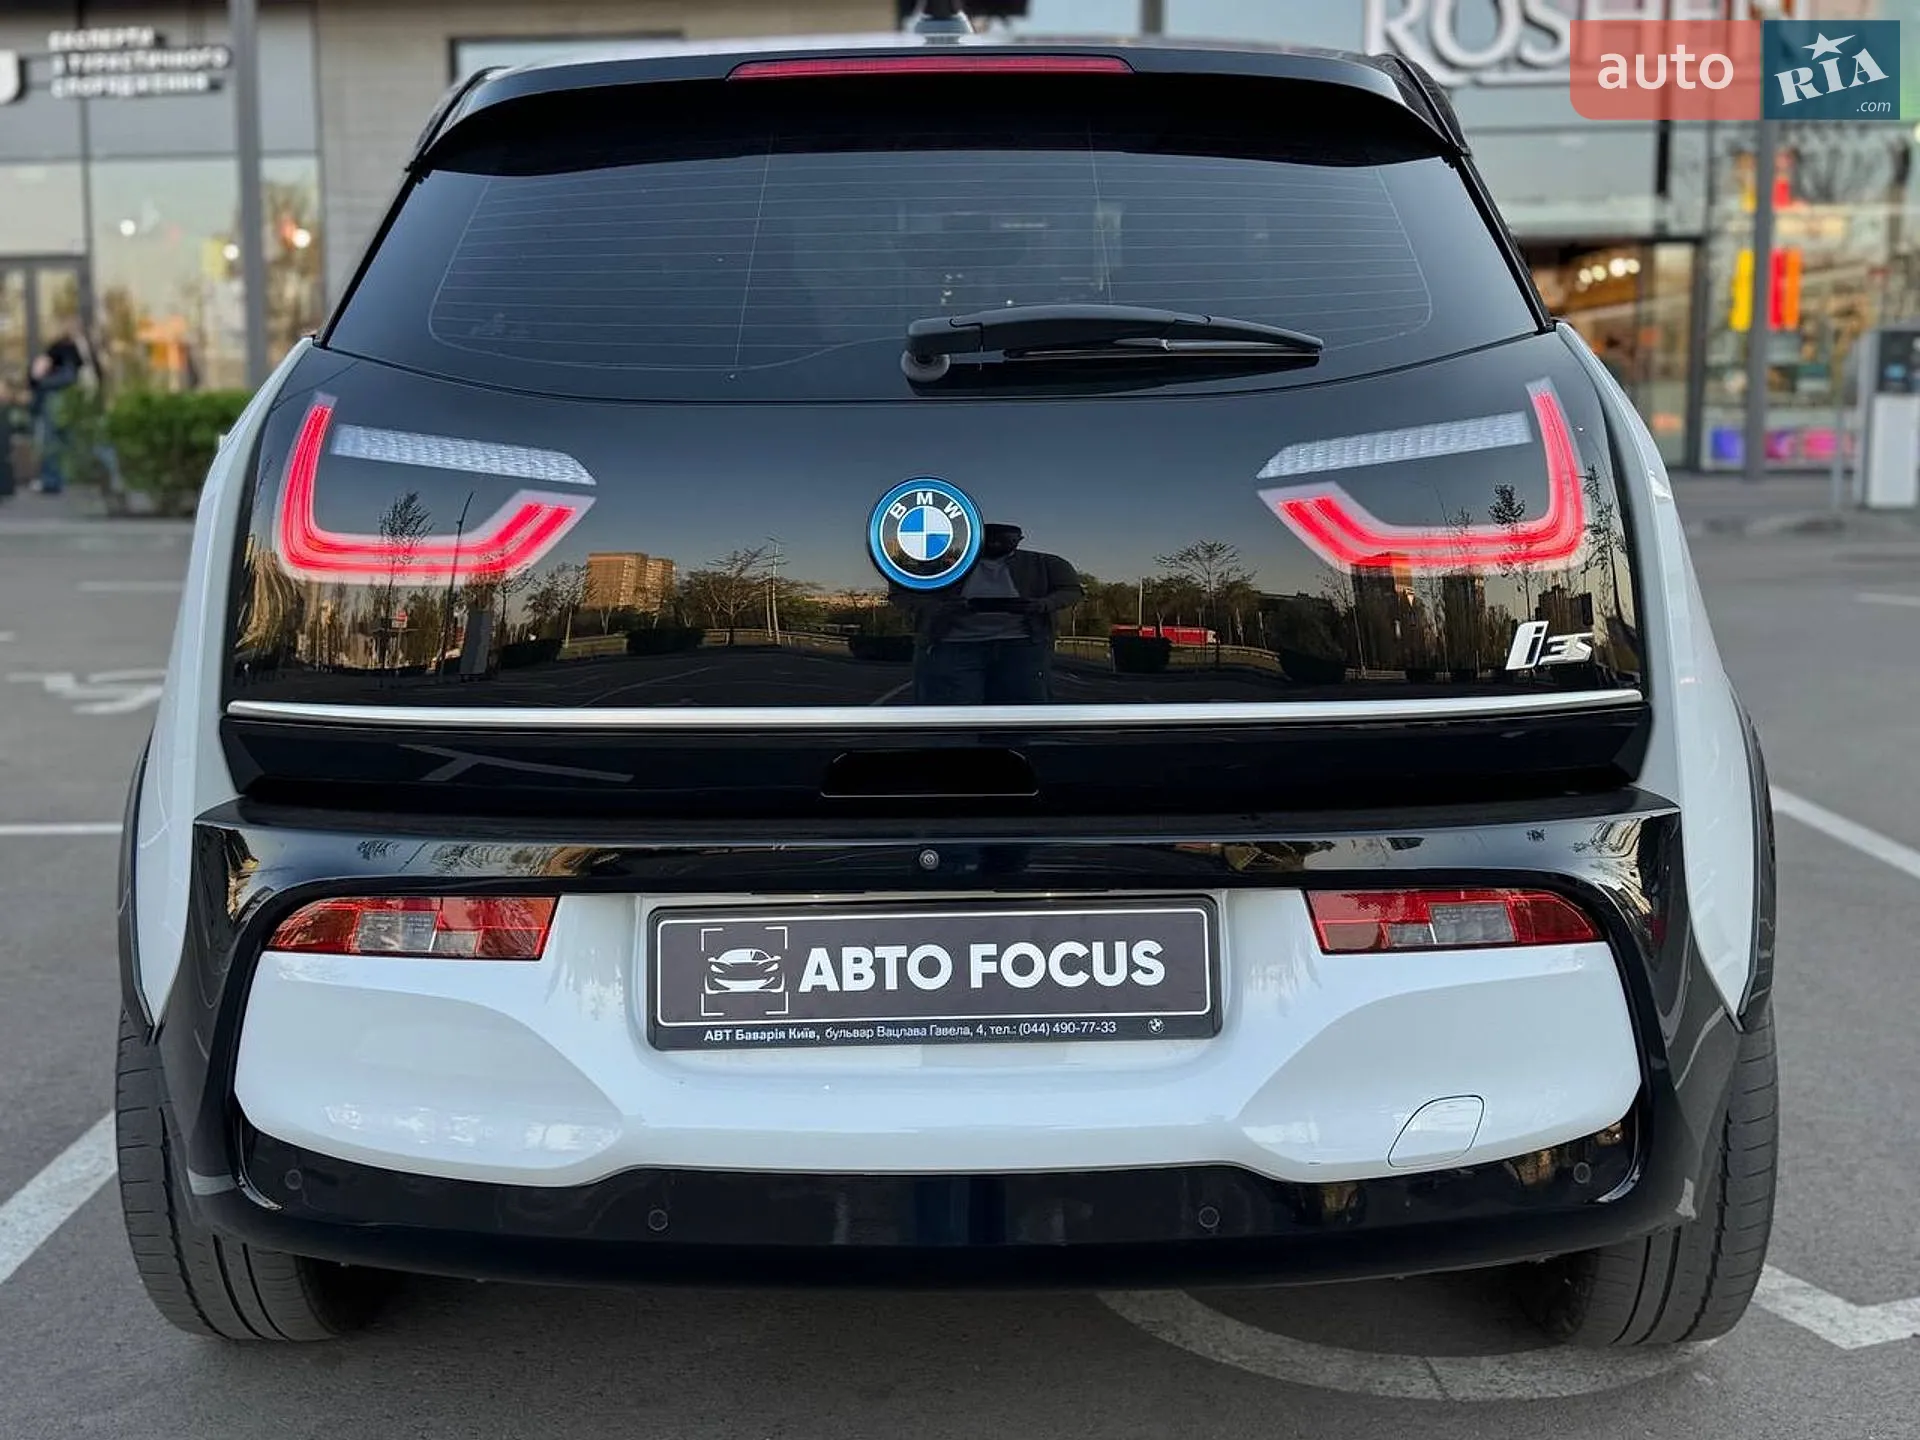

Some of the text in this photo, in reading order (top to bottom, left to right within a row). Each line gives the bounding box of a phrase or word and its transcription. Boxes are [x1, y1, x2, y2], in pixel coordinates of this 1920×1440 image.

[889, 491, 963, 520] BMW
[970, 940, 1165, 989] FOCUS
[704, 1029, 732, 1041] АВТ
[735, 1027, 786, 1042] Баварія
[788, 1024, 821, 1040] Київ,
[825, 1025, 874, 1041] бульвар
[877, 1024, 927, 1039] Вацлава
[929, 1023, 974, 1038] Гавела,
[976, 1024, 988, 1036] 4,
[1019, 1021, 1050, 1037] (044)
[1053, 1021, 1117, 1034] 490-77-33
